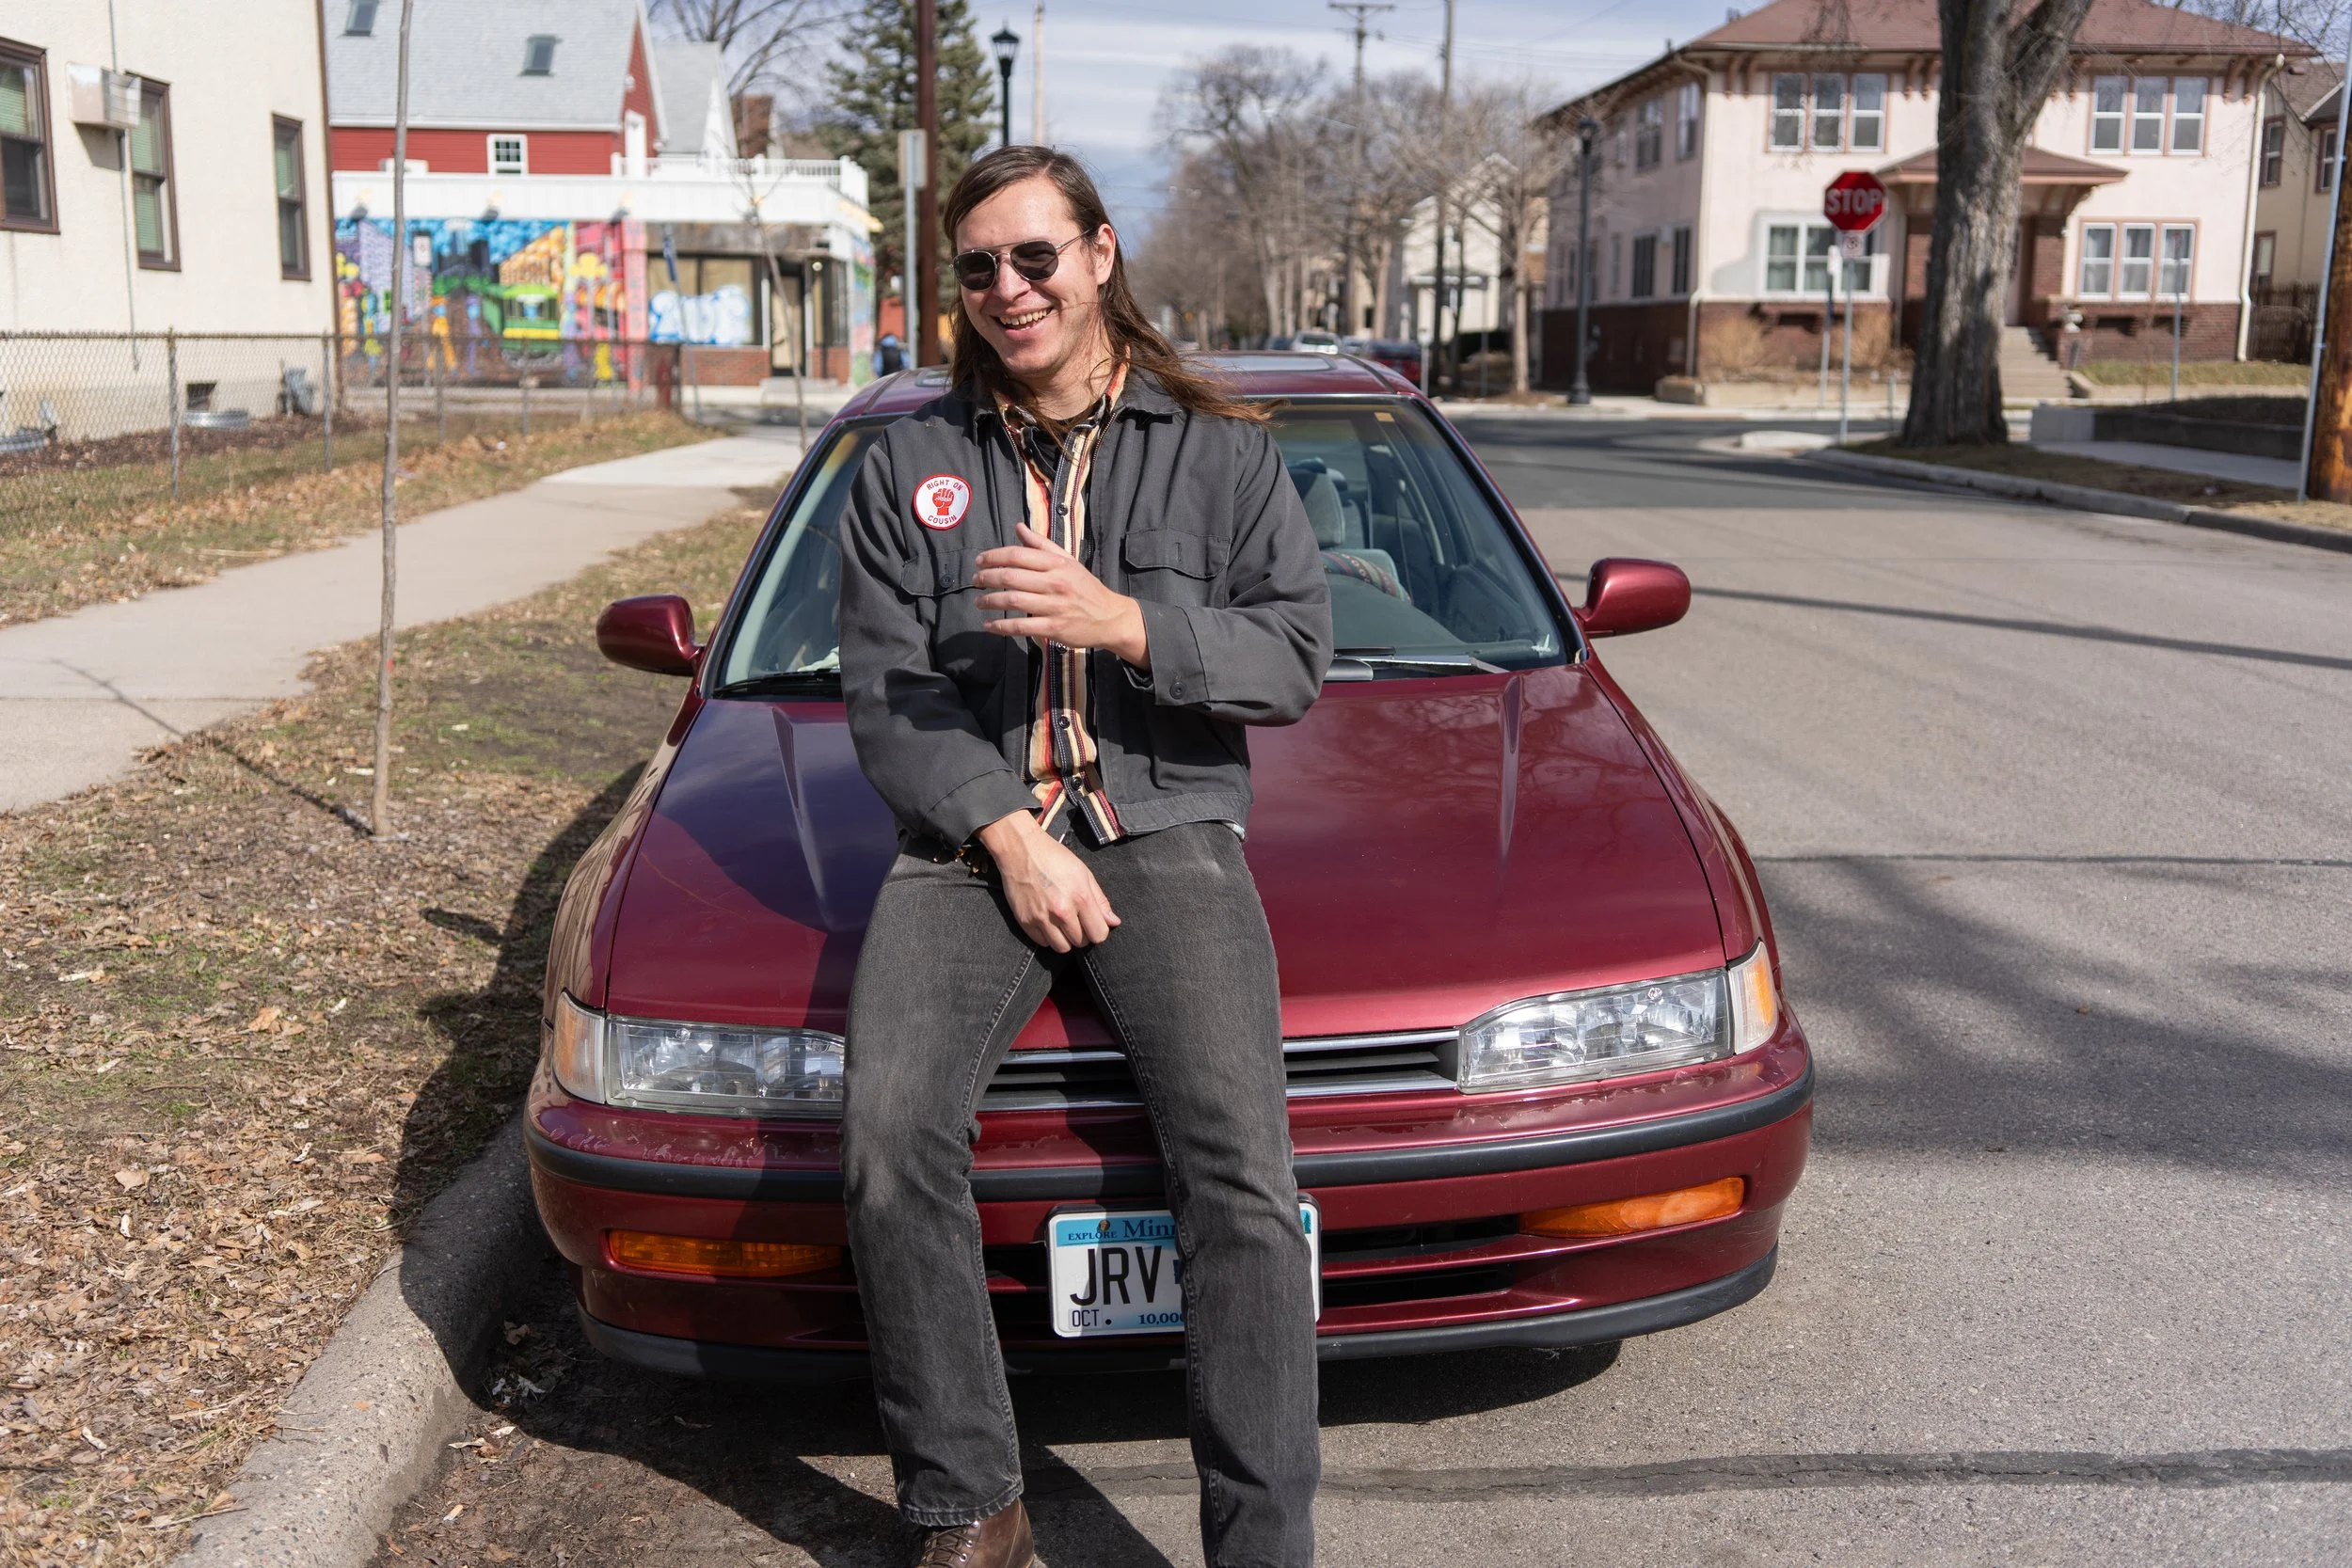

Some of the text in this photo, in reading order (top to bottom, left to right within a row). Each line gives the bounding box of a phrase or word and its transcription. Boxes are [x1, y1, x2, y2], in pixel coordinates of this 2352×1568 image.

[1826, 188, 1883, 215] STOP
[927, 479, 964, 492] RIGHT ON
[928, 515, 958, 525] COUSIN
[1068, 1230, 1118, 1241] EXPLORE
[1070, 1245, 1163, 1307] JRV
[1072, 1308, 1100, 1327] OCT
